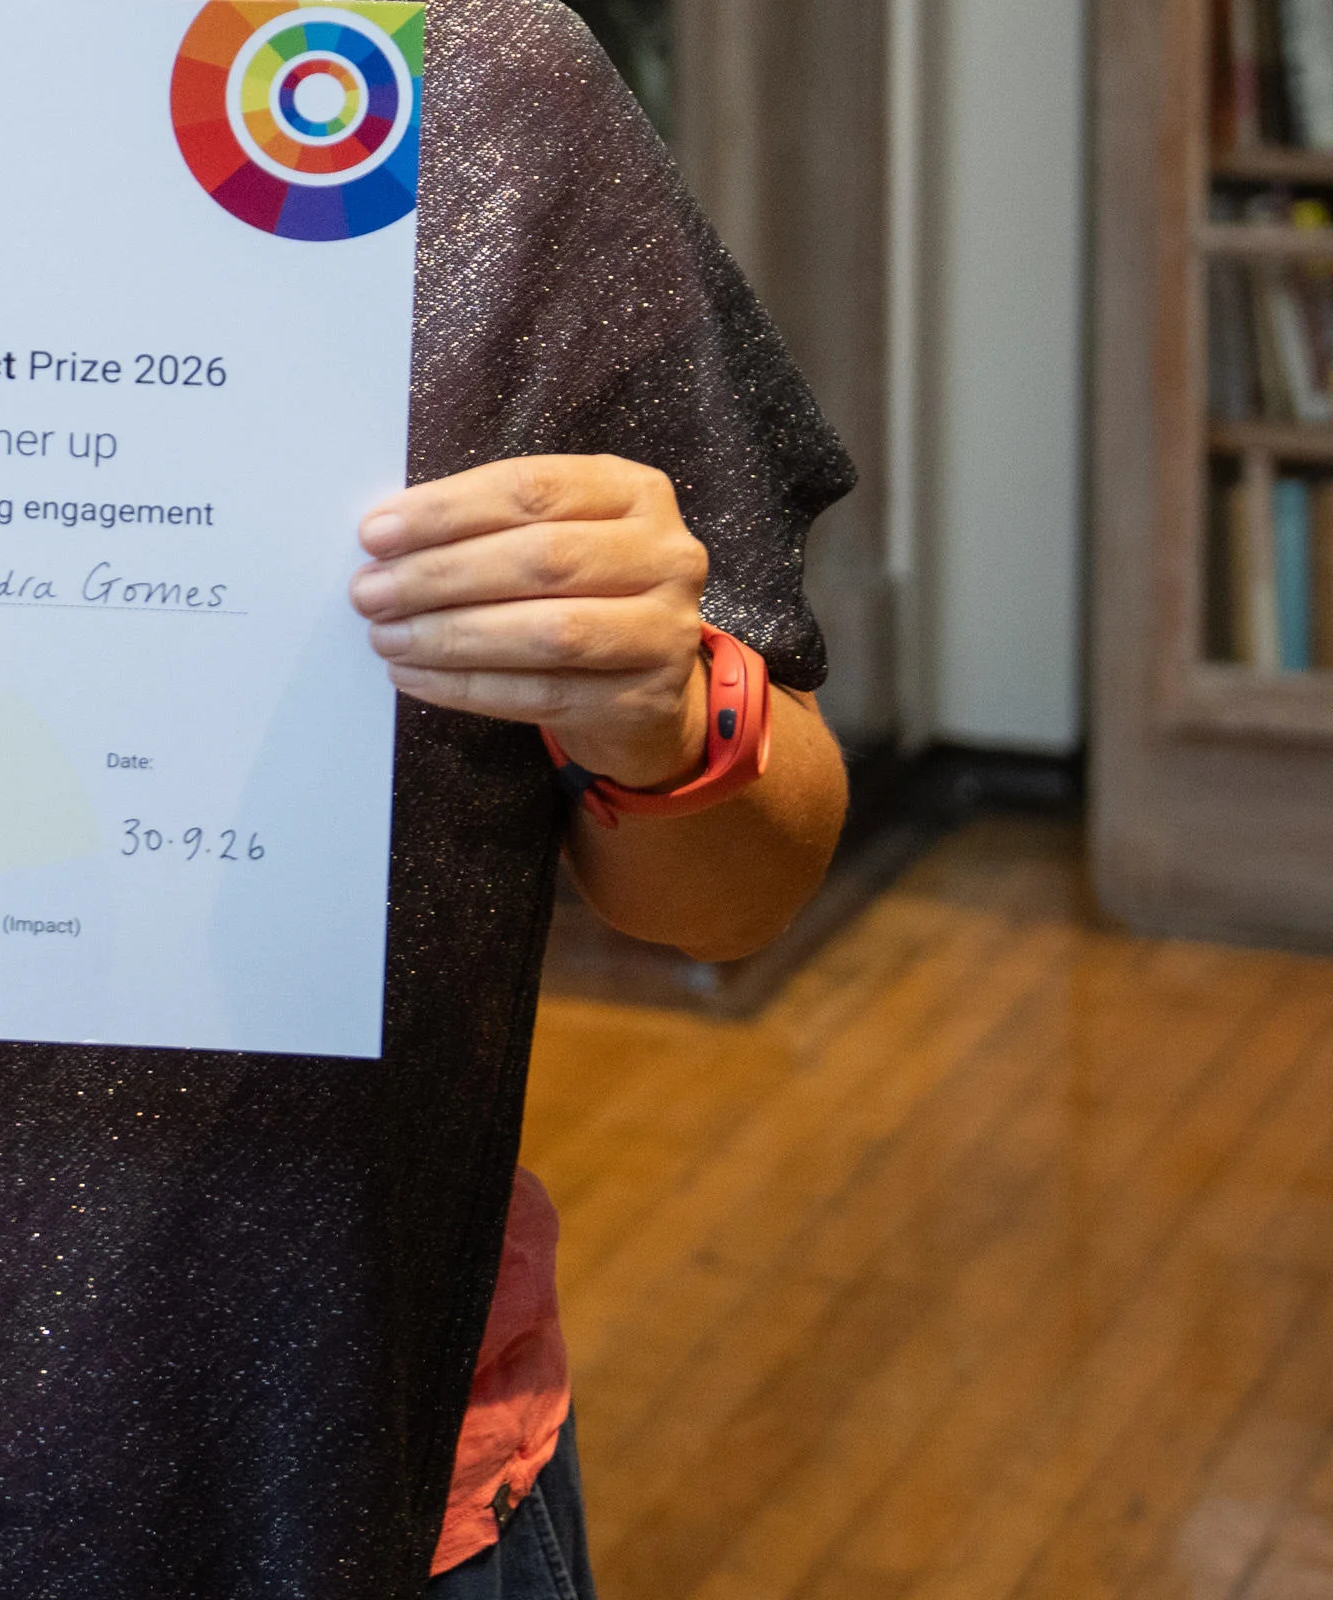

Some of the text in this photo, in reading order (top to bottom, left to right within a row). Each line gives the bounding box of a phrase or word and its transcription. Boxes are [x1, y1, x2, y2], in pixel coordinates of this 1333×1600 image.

[29, 350, 123, 384] Prize
[133, 353, 228, 387] 2026
[69, 430, 118, 468] up
[23, 498, 214, 529] engagement
[82, 561, 229, 608] Gomes
[106, 752, 154, 770] Date:
[1, 914, 82, 936] (Impact)
